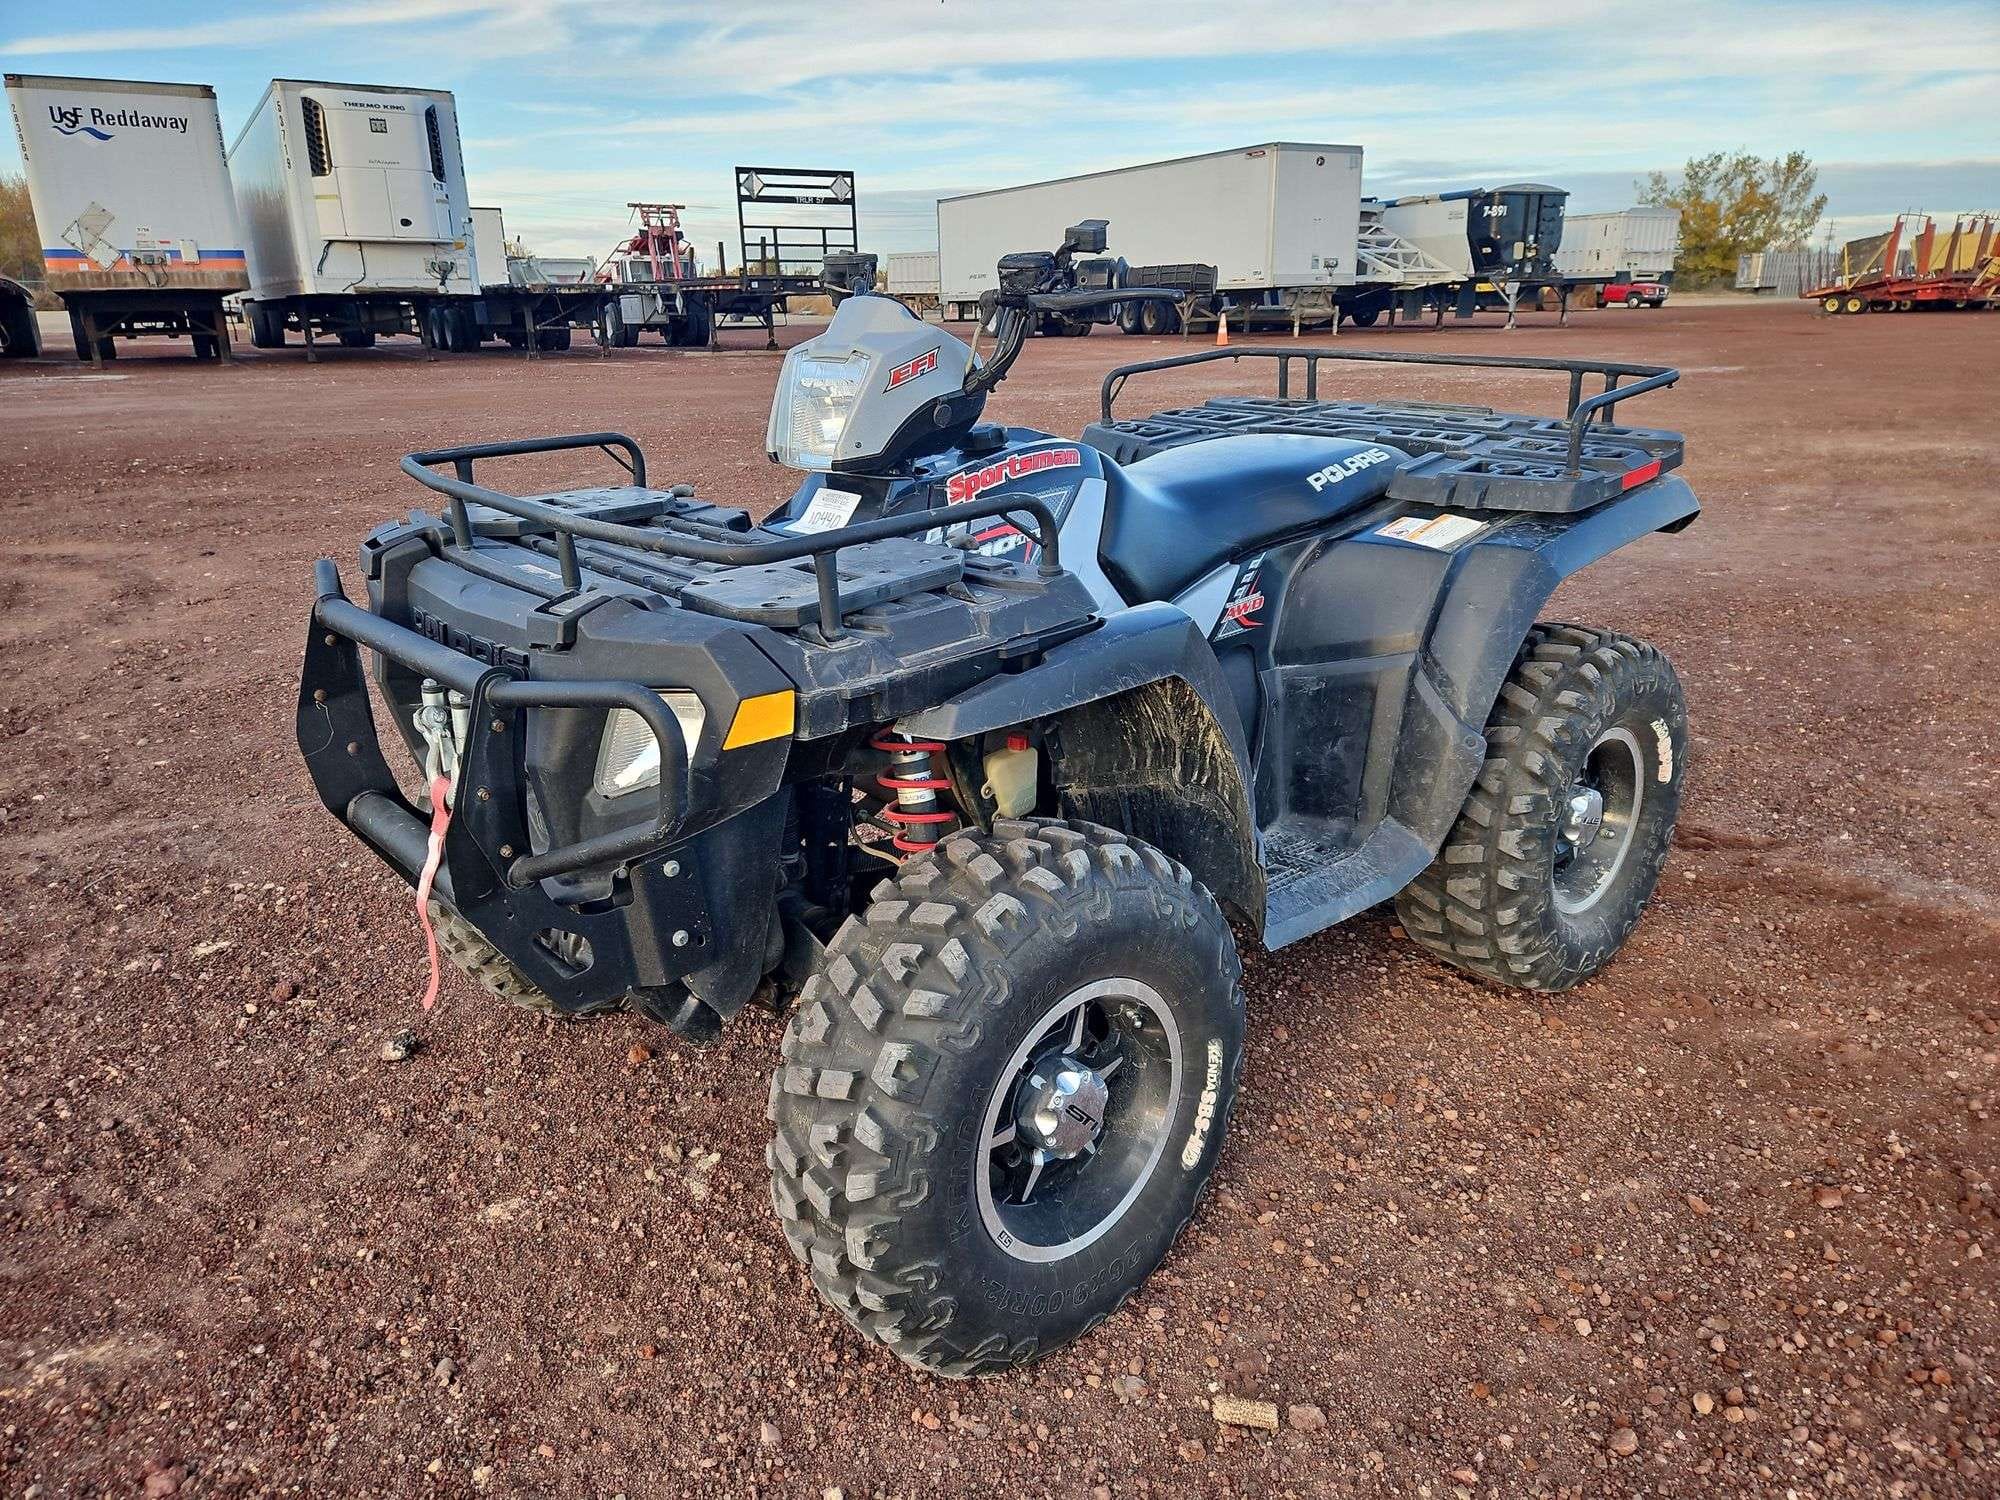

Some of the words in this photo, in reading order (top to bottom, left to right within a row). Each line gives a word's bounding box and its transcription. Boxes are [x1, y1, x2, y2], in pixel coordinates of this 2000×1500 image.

[48, 105, 83, 129] USF
[90, 107, 188, 133] Reddaway
[343, 101, 381, 109] THERMO
[1482, 204, 1508, 217] 7-891
[888, 348, 938, 389] EFI
[947, 448, 1081, 506] Sportsman
[1306, 447, 1391, 493] POLARIS
[1221, 595, 1265, 624] AWD
[1206, 1039, 1223, 1092] KENDA
[1065, 1104, 1099, 1132] STI
